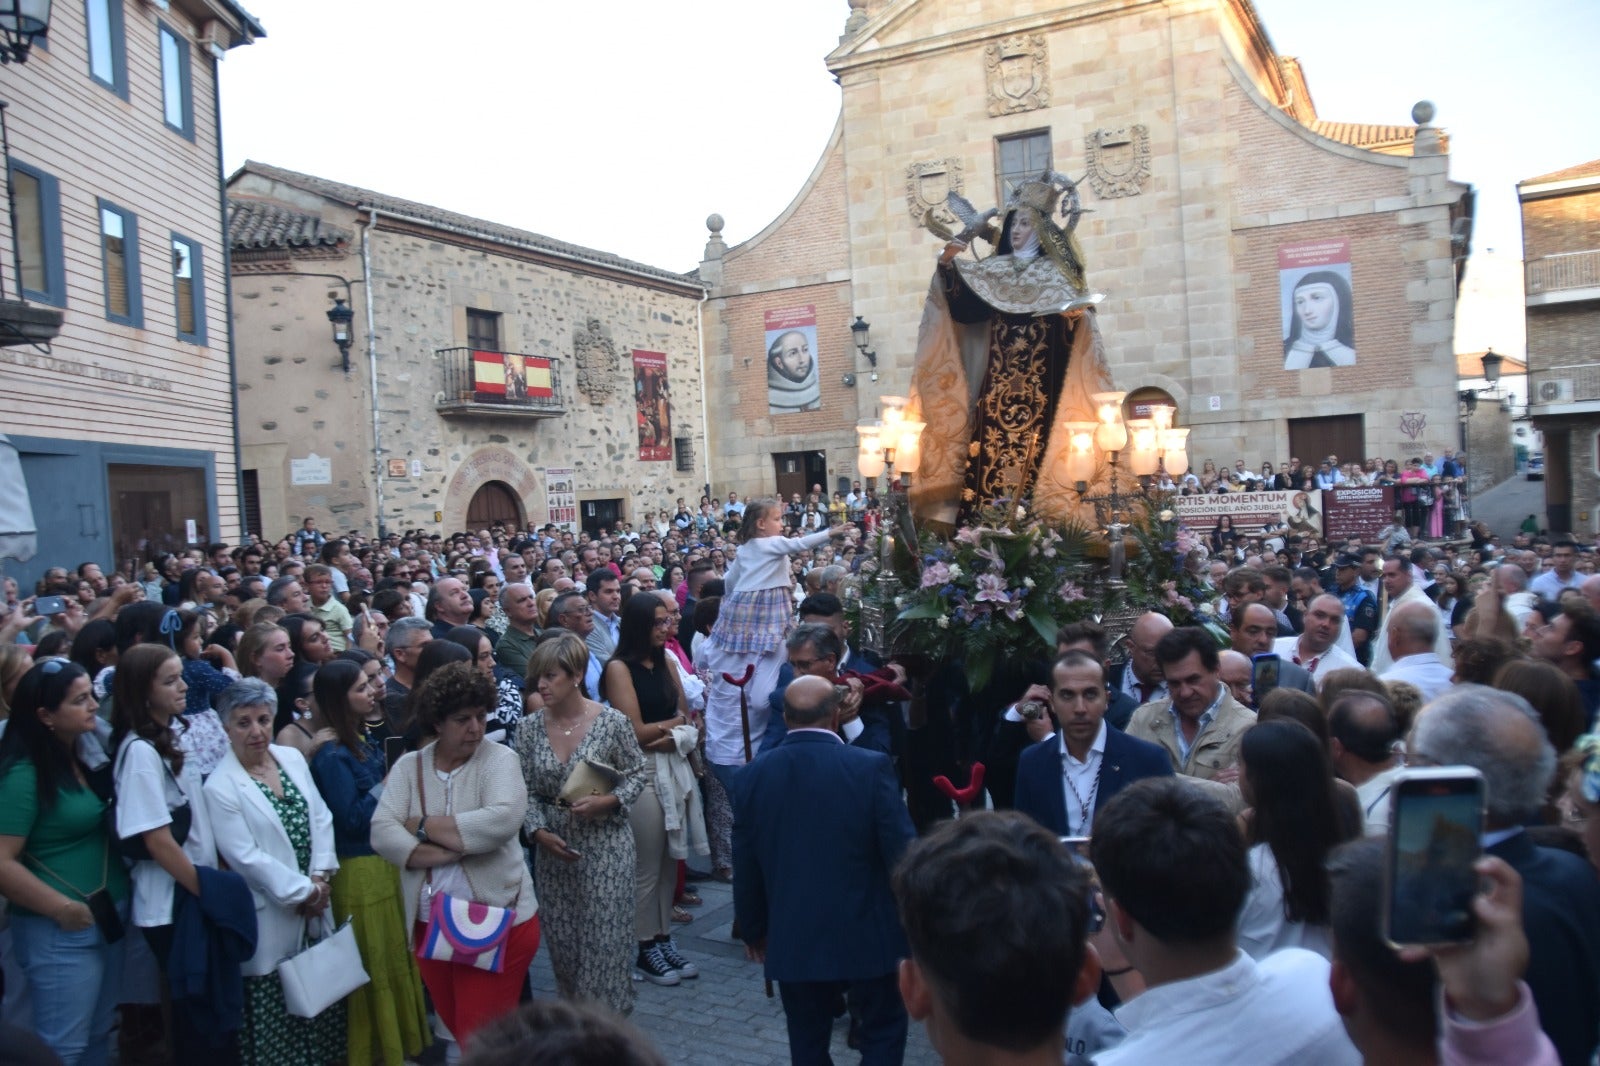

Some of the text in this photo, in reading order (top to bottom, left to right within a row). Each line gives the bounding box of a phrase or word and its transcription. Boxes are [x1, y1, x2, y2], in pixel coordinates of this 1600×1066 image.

[1336, 488, 1383, 496] EXPOSICIÓN
[1209, 493, 1287, 505] MOMENTUM
[1218, 505, 1233, 513] DEL
[1234, 503, 1253, 512] AÑO
[1253, 503, 1288, 511] JUBILAR
